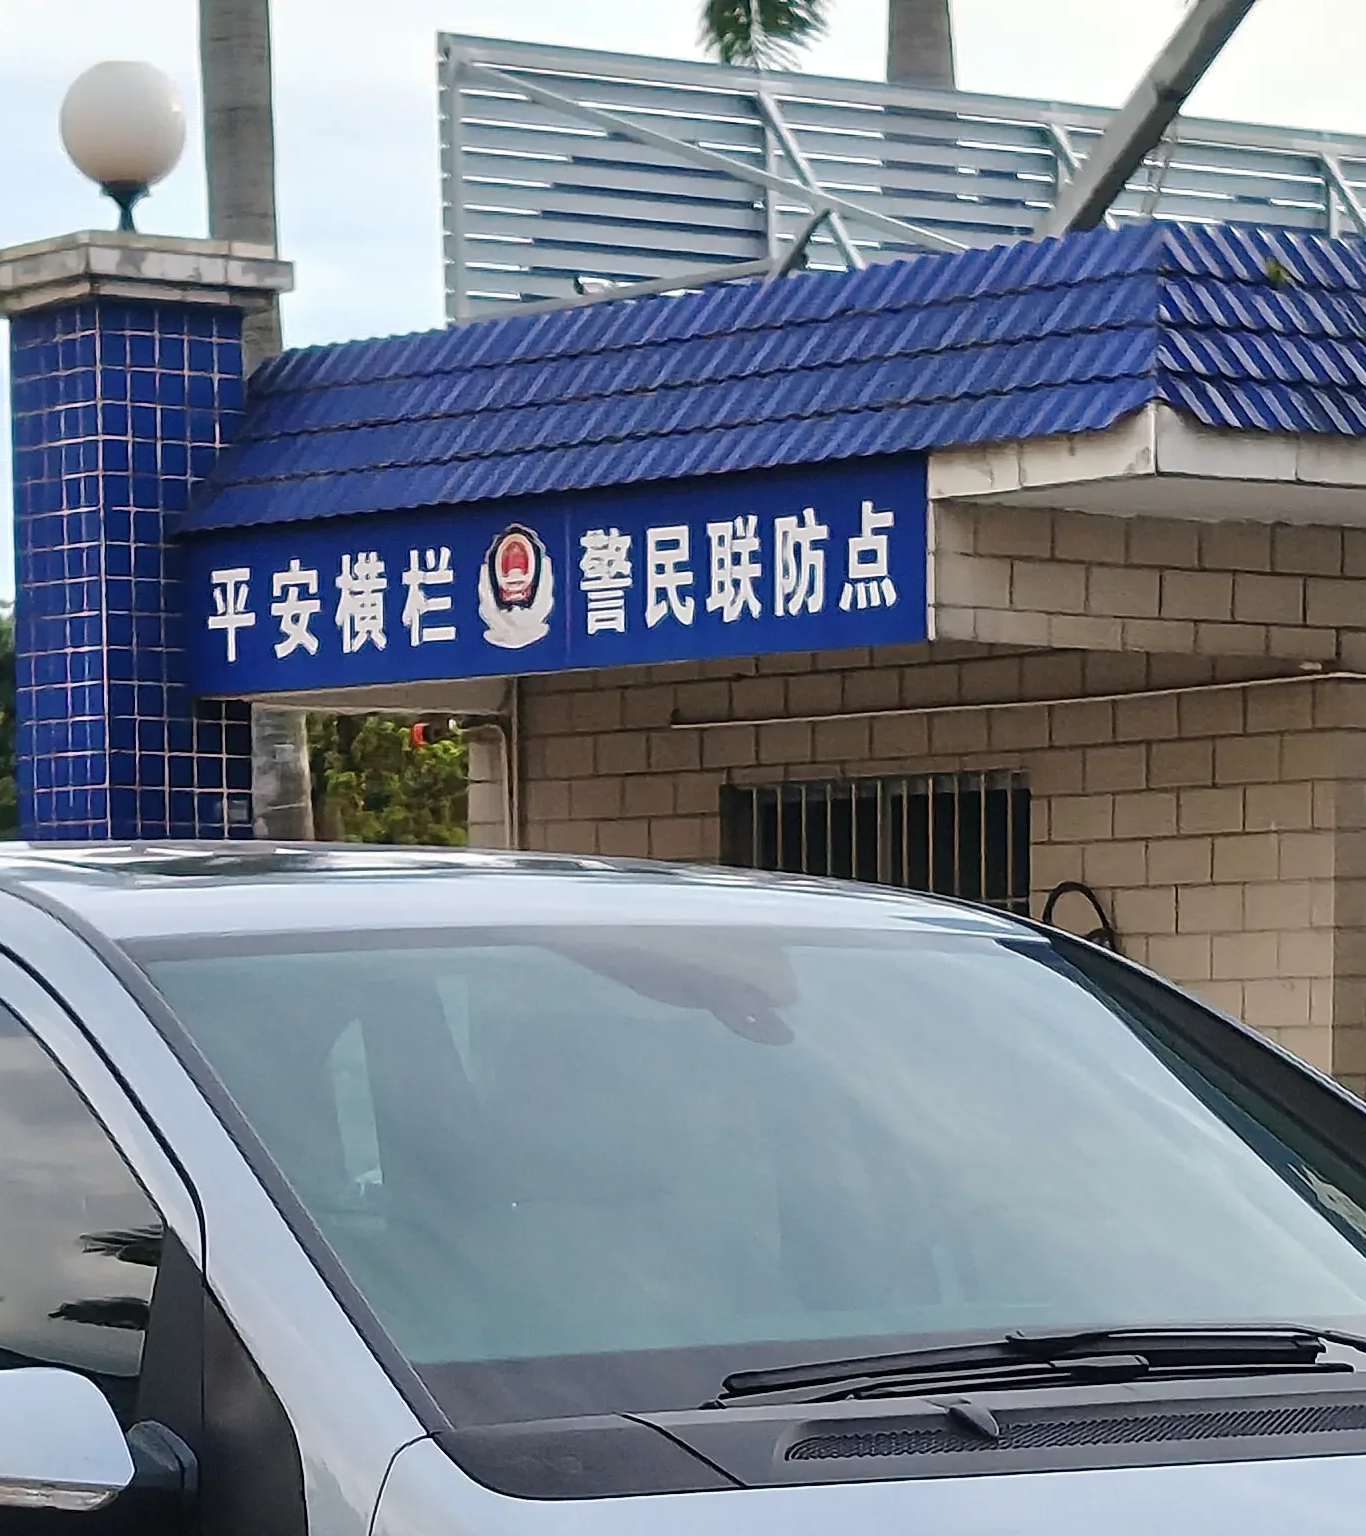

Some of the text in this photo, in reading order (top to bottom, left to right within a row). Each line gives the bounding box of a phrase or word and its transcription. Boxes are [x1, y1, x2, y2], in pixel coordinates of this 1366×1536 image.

[208, 500, 898, 663] 平安横栏 警民联防点
